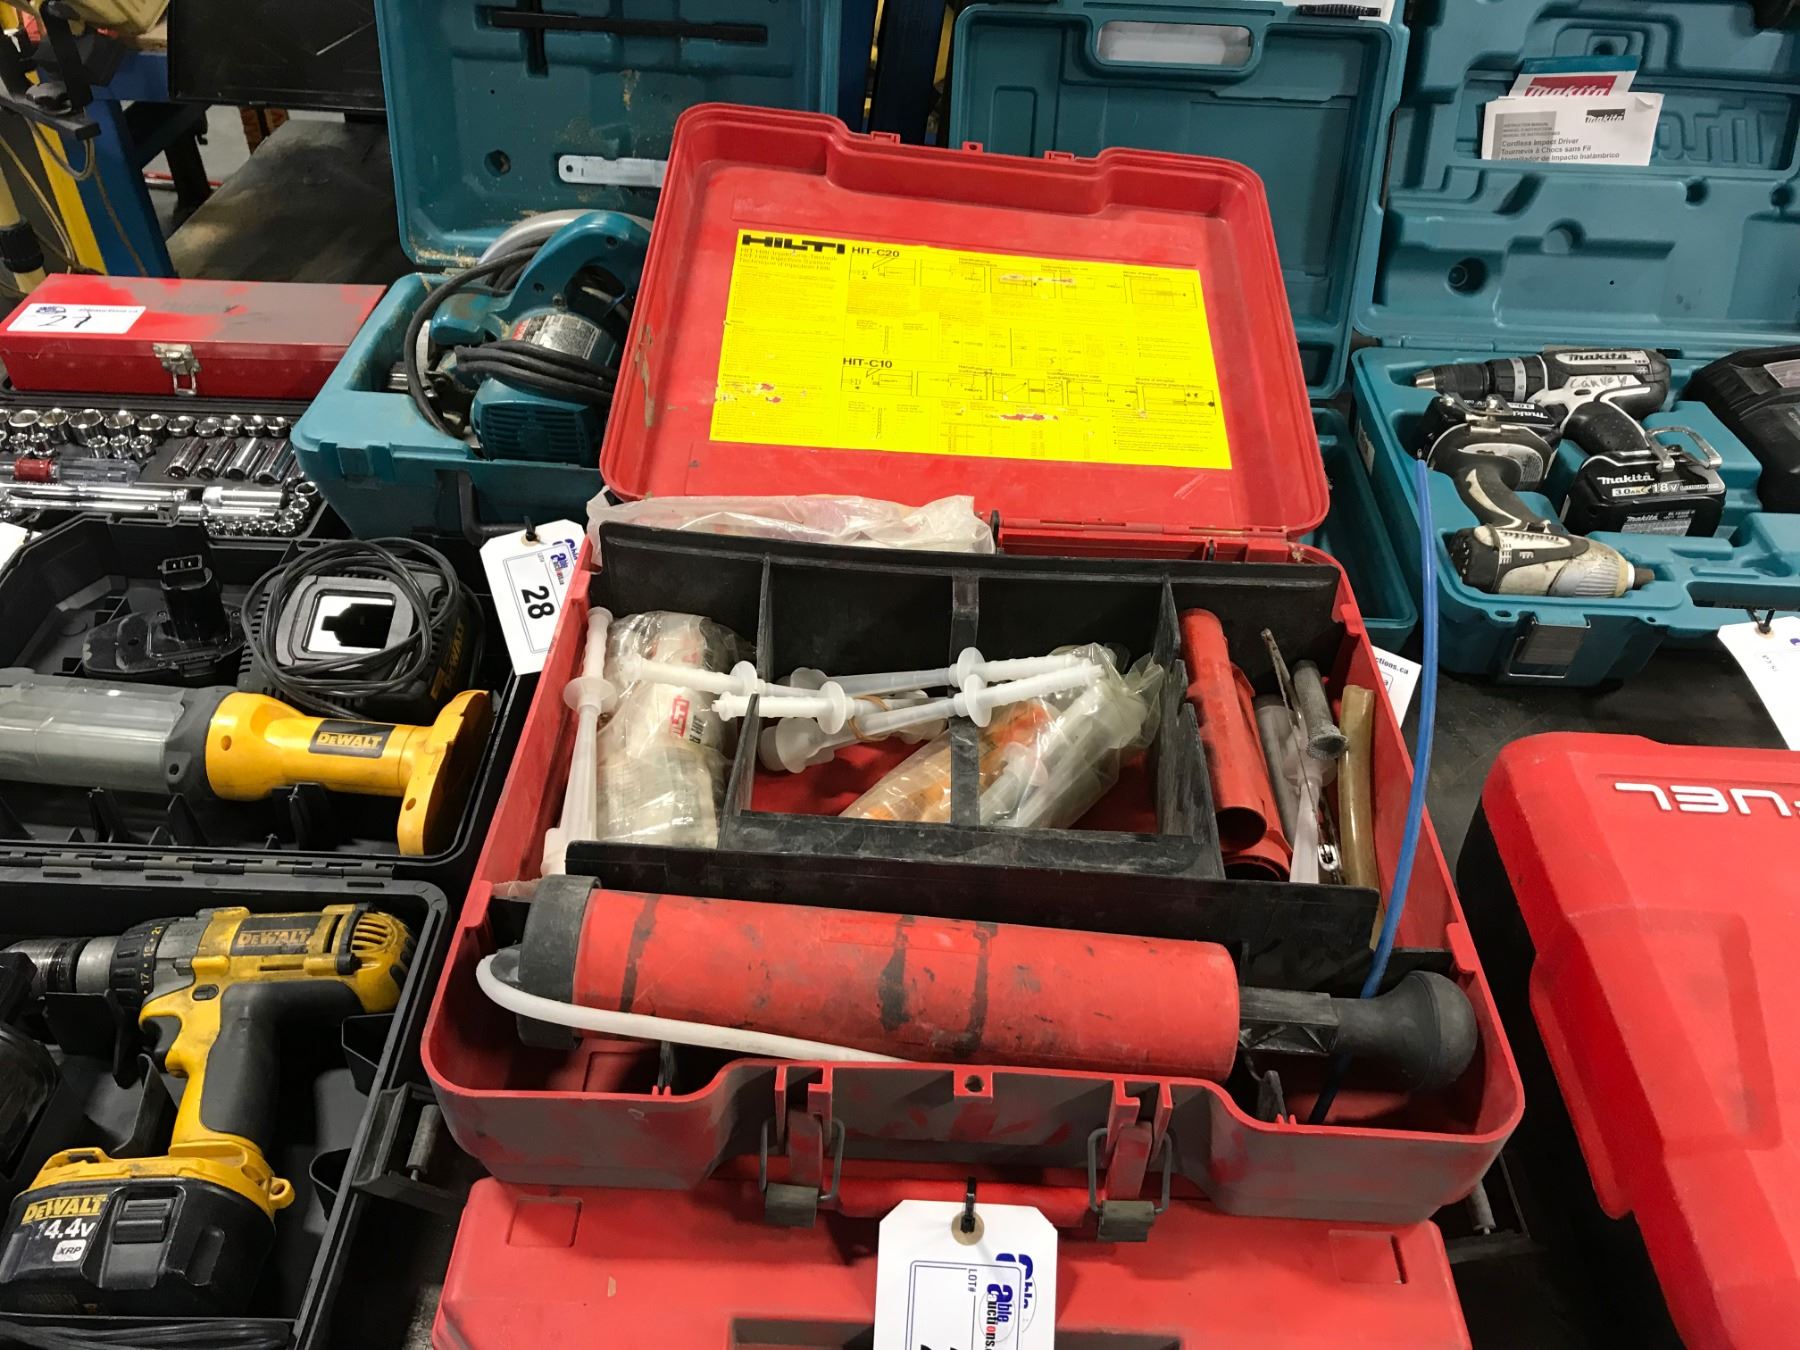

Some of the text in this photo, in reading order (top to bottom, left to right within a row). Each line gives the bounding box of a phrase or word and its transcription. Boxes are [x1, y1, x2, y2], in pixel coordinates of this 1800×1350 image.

[1534, 139, 1557, 147] Impact
[1558, 137, 1580, 145] Driver
[1551, 153, 1579, 161] Impacto
[742, 234, 845, 254] HILTI
[851, 246, 900, 258] HIT-C20
[38, 310, 92, 328] 27
[842, 356, 893, 370] HIT-C10
[1568, 353, 1631, 361] makita
[1596, 473, 1656, 485] makita
[521, 585, 555, 619] 28
[1375, 657, 1409, 675] ctions.ca
[1614, 782, 1800, 816] UEL
[56, 1246, 82, 1255] XRP
[967, 1268, 978, 1292] LOT#
[985, 1290, 999, 1350] auctions.
